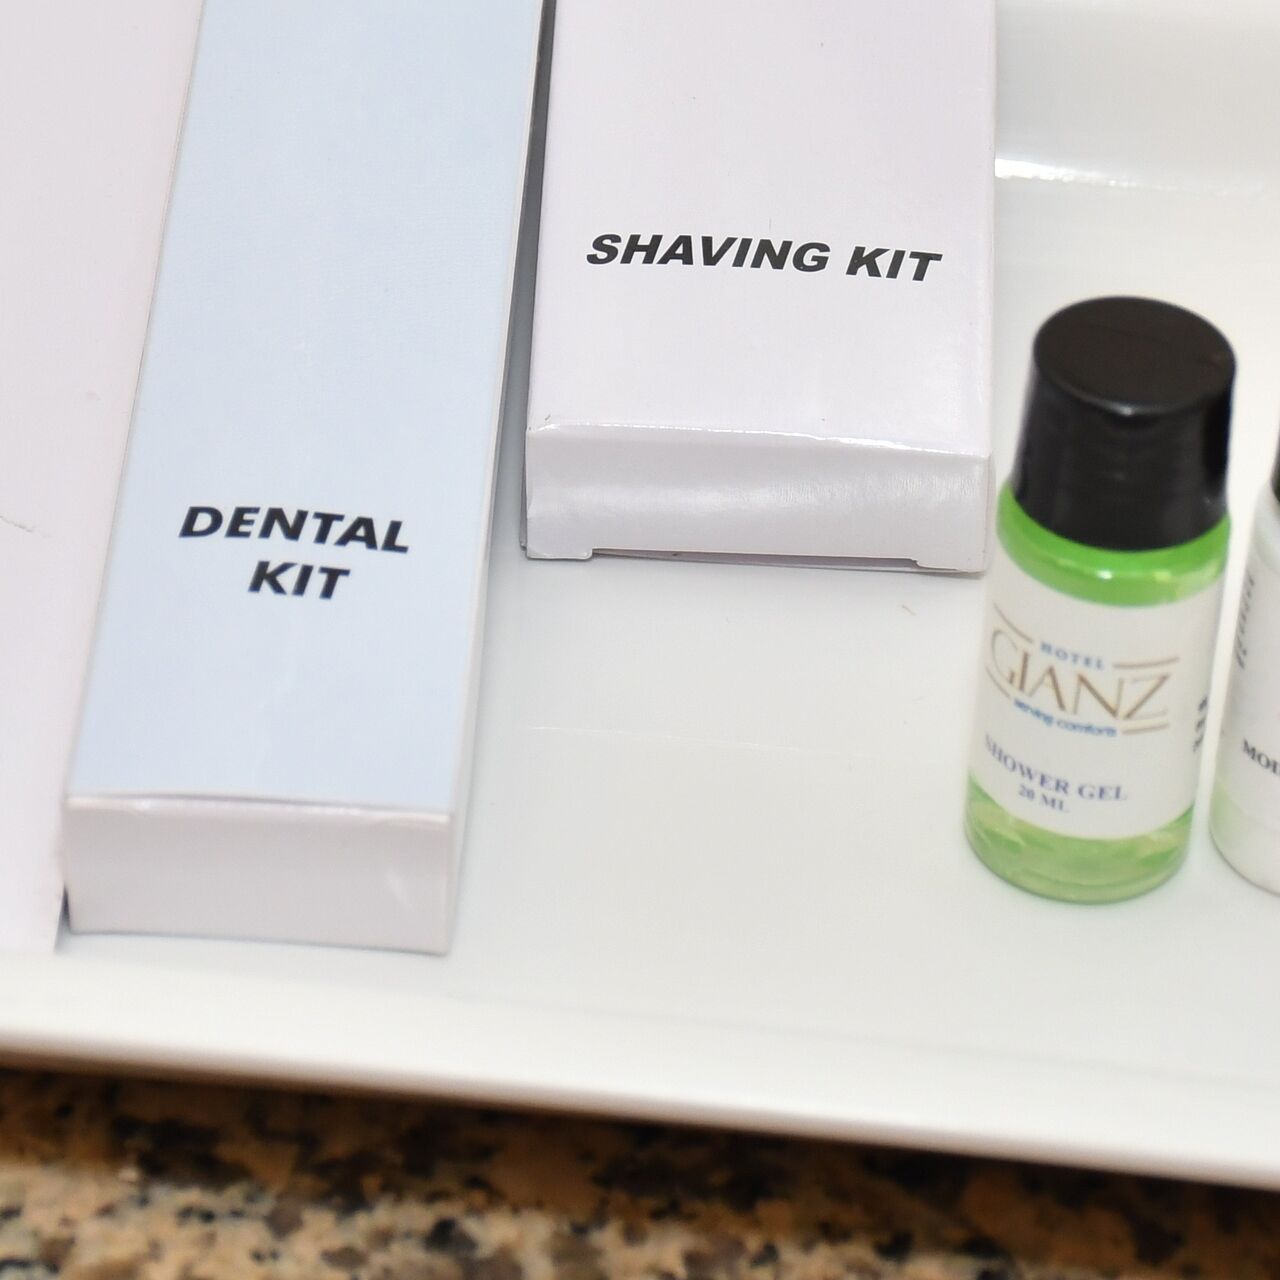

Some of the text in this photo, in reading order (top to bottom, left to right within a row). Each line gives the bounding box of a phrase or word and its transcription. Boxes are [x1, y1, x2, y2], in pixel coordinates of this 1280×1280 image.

[586, 233, 943, 283] SHAVING KIT
[177, 504, 412, 554] DENTAL
[247, 560, 352, 601] KIT
[991, 628, 1170, 720] GIANZ
[1040, 641, 1104, 670] HOTEL
[985, 734, 1128, 802] SHOWER GEL
[1018, 783, 1069, 812] 20 ML
